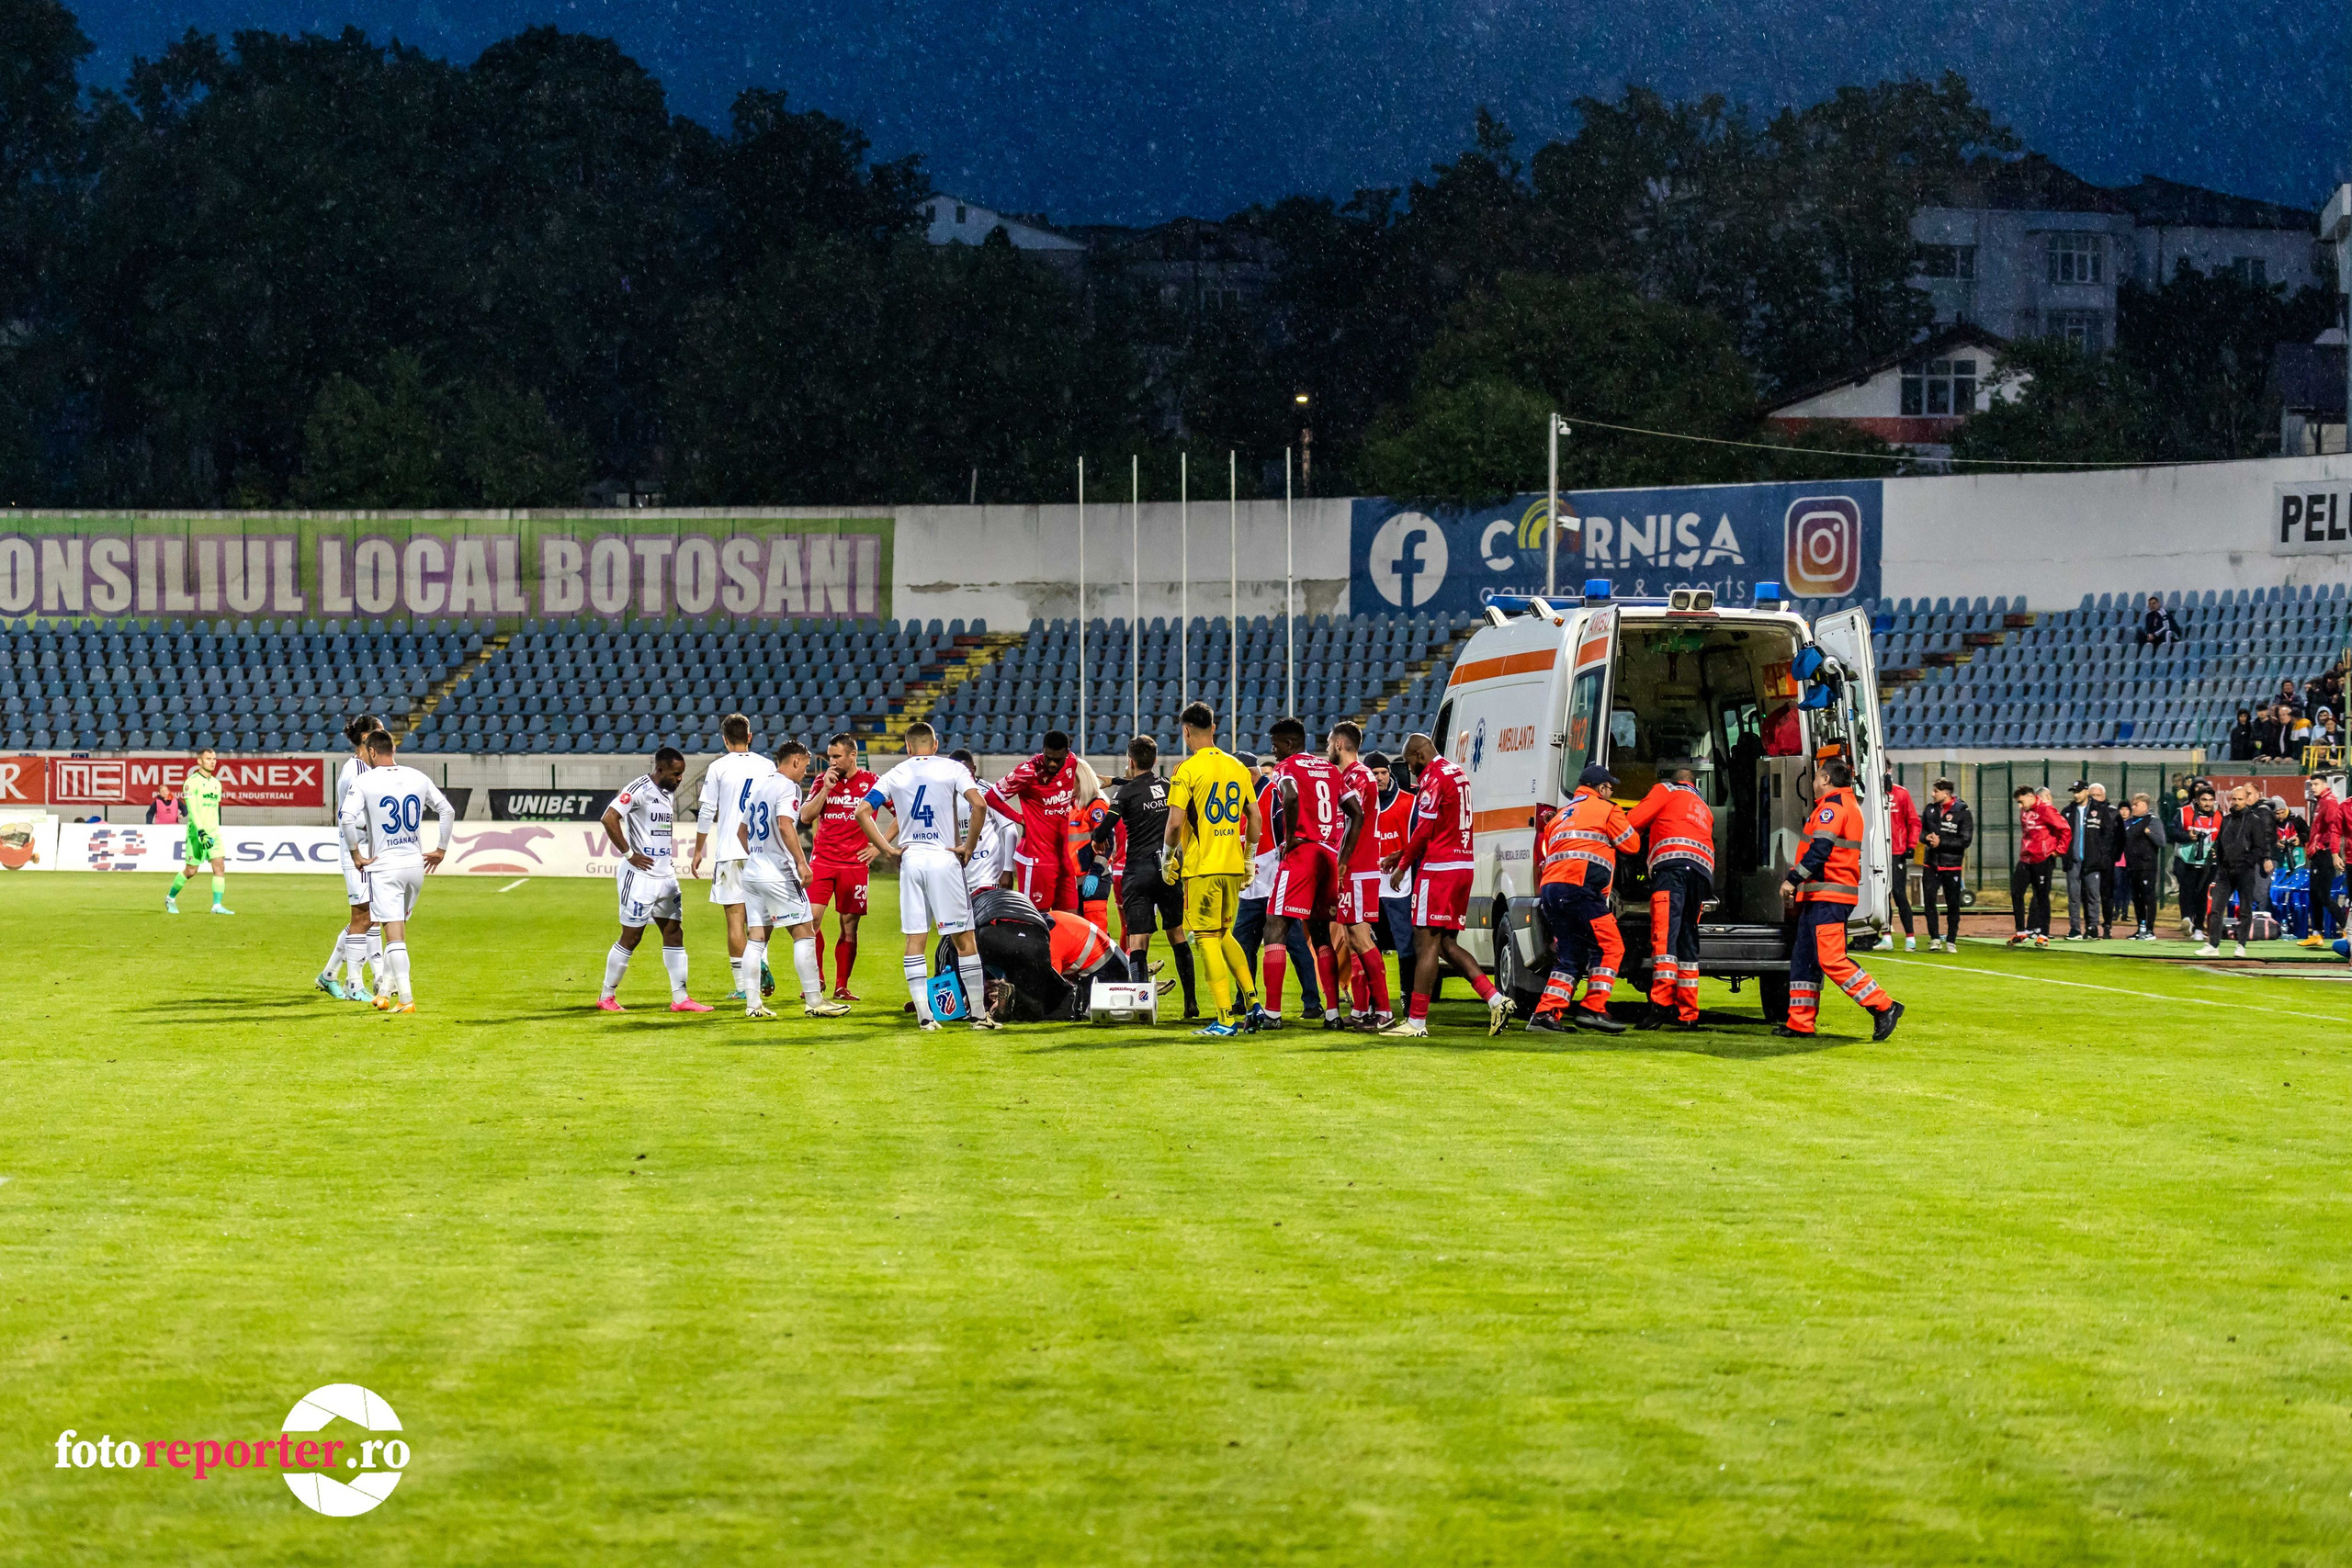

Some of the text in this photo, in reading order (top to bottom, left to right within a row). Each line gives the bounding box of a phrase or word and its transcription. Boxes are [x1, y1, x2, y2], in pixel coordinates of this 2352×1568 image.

[2281, 492, 2352, 543] PEL
[0, 537, 875, 614] ONSILIUL LOCAL BOTOSANI
[1498, 725, 1535, 753] AMBULANTA
[238, 792, 294, 800] INDUSTRIALE
[379, 794, 421, 835] 30
[507, 795, 593, 815] UNIBET
[910, 784, 934, 828] 4
[1204, 781, 1240, 825] 68
[1315, 781, 1332, 823] 8
[1457, 784, 1474, 830] 19
[912, 831, 939, 840] MIRON
[854, 885, 867, 899] 23
[1338, 892, 1351, 908] 24
